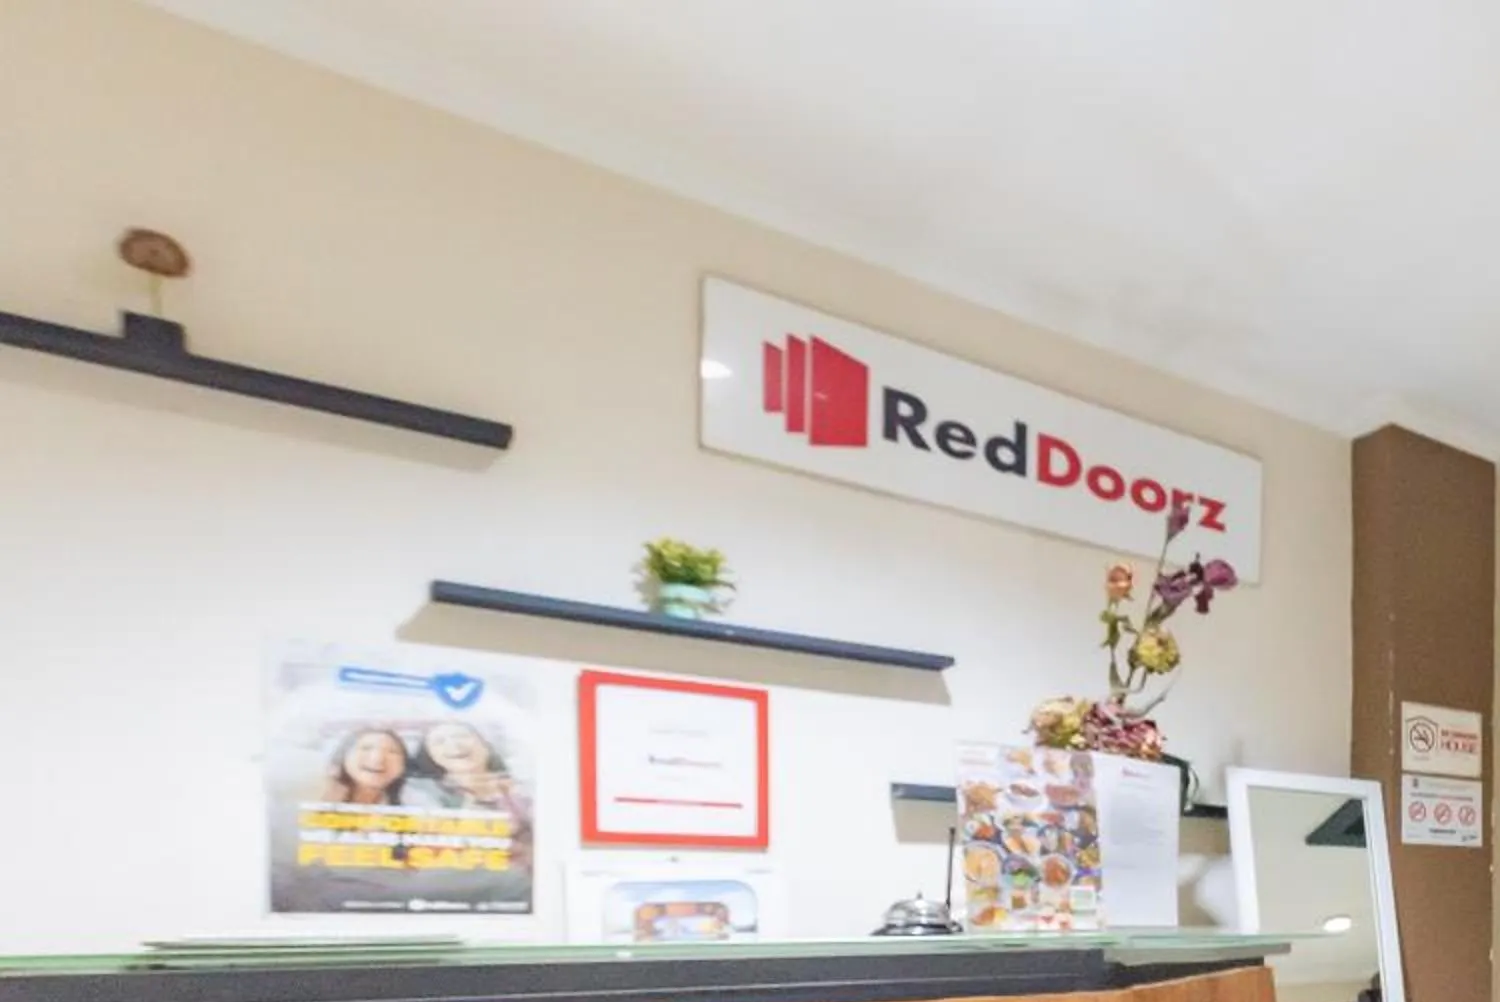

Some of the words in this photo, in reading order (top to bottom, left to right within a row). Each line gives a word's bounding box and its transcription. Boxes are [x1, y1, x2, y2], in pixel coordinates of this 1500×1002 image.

[882, 386, 1226, 533] RedDoorz
[298, 843, 403, 868] FEEL
[406, 846, 512, 871] SAFE
